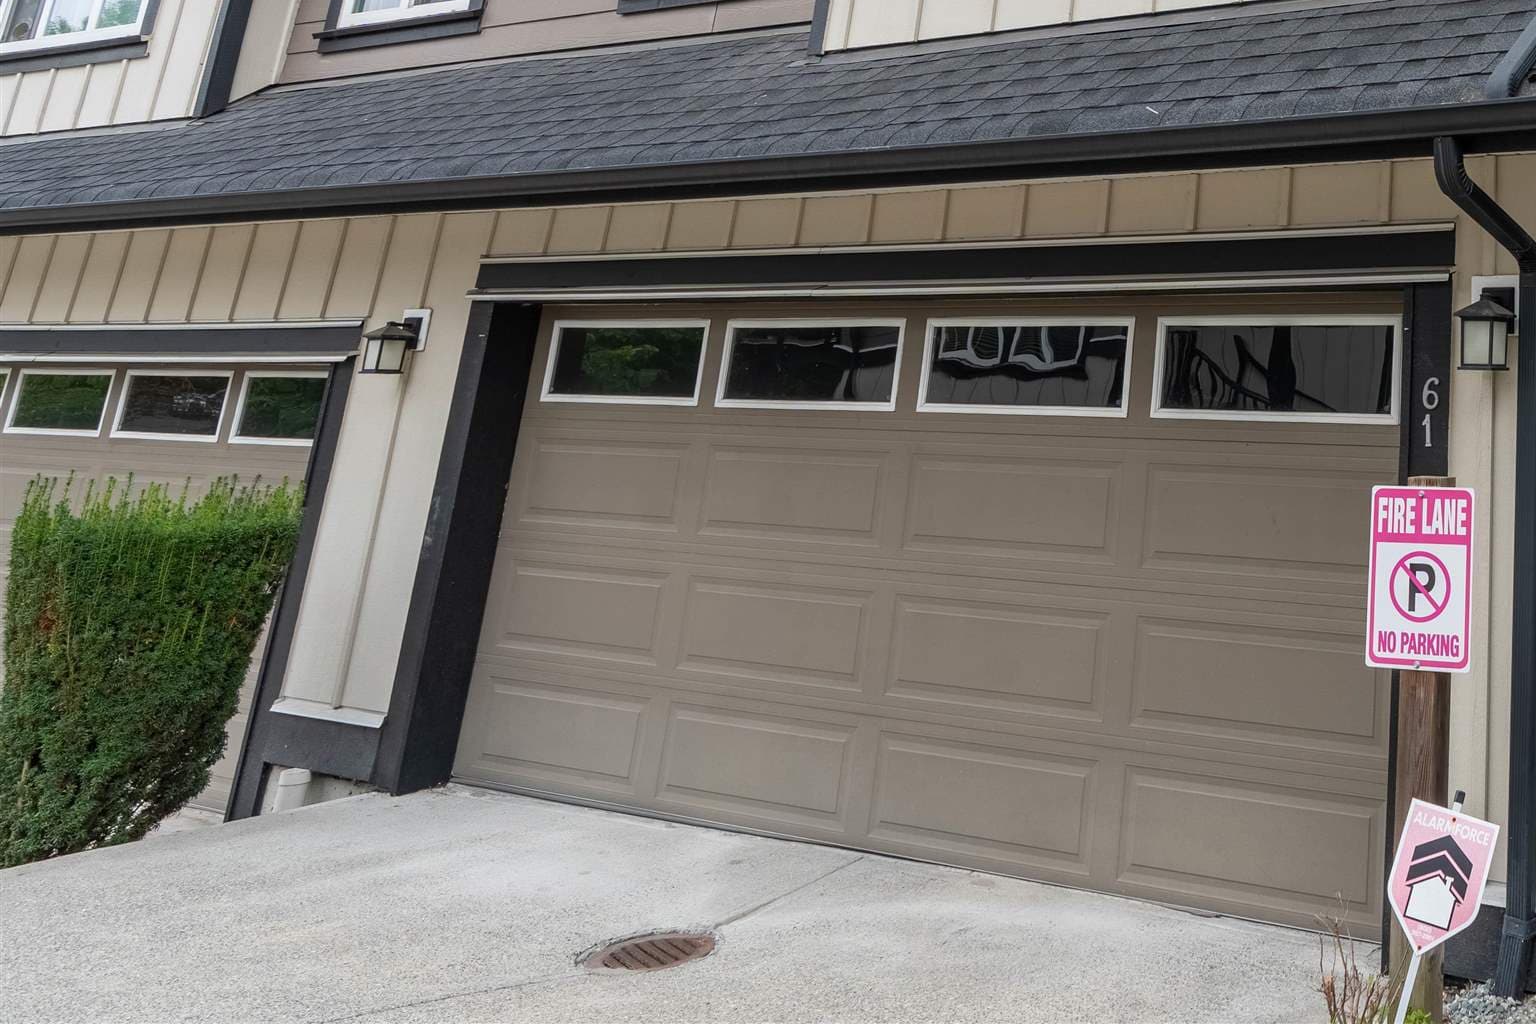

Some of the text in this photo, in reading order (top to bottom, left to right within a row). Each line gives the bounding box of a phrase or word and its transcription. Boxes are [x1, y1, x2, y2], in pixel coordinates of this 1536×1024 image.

[1421, 377, 1440, 447] 61
[1377, 496, 1468, 536] FIRE LANE
[1408, 563, 1436, 612] P
[1377, 630, 1460, 658] NO PARKING
